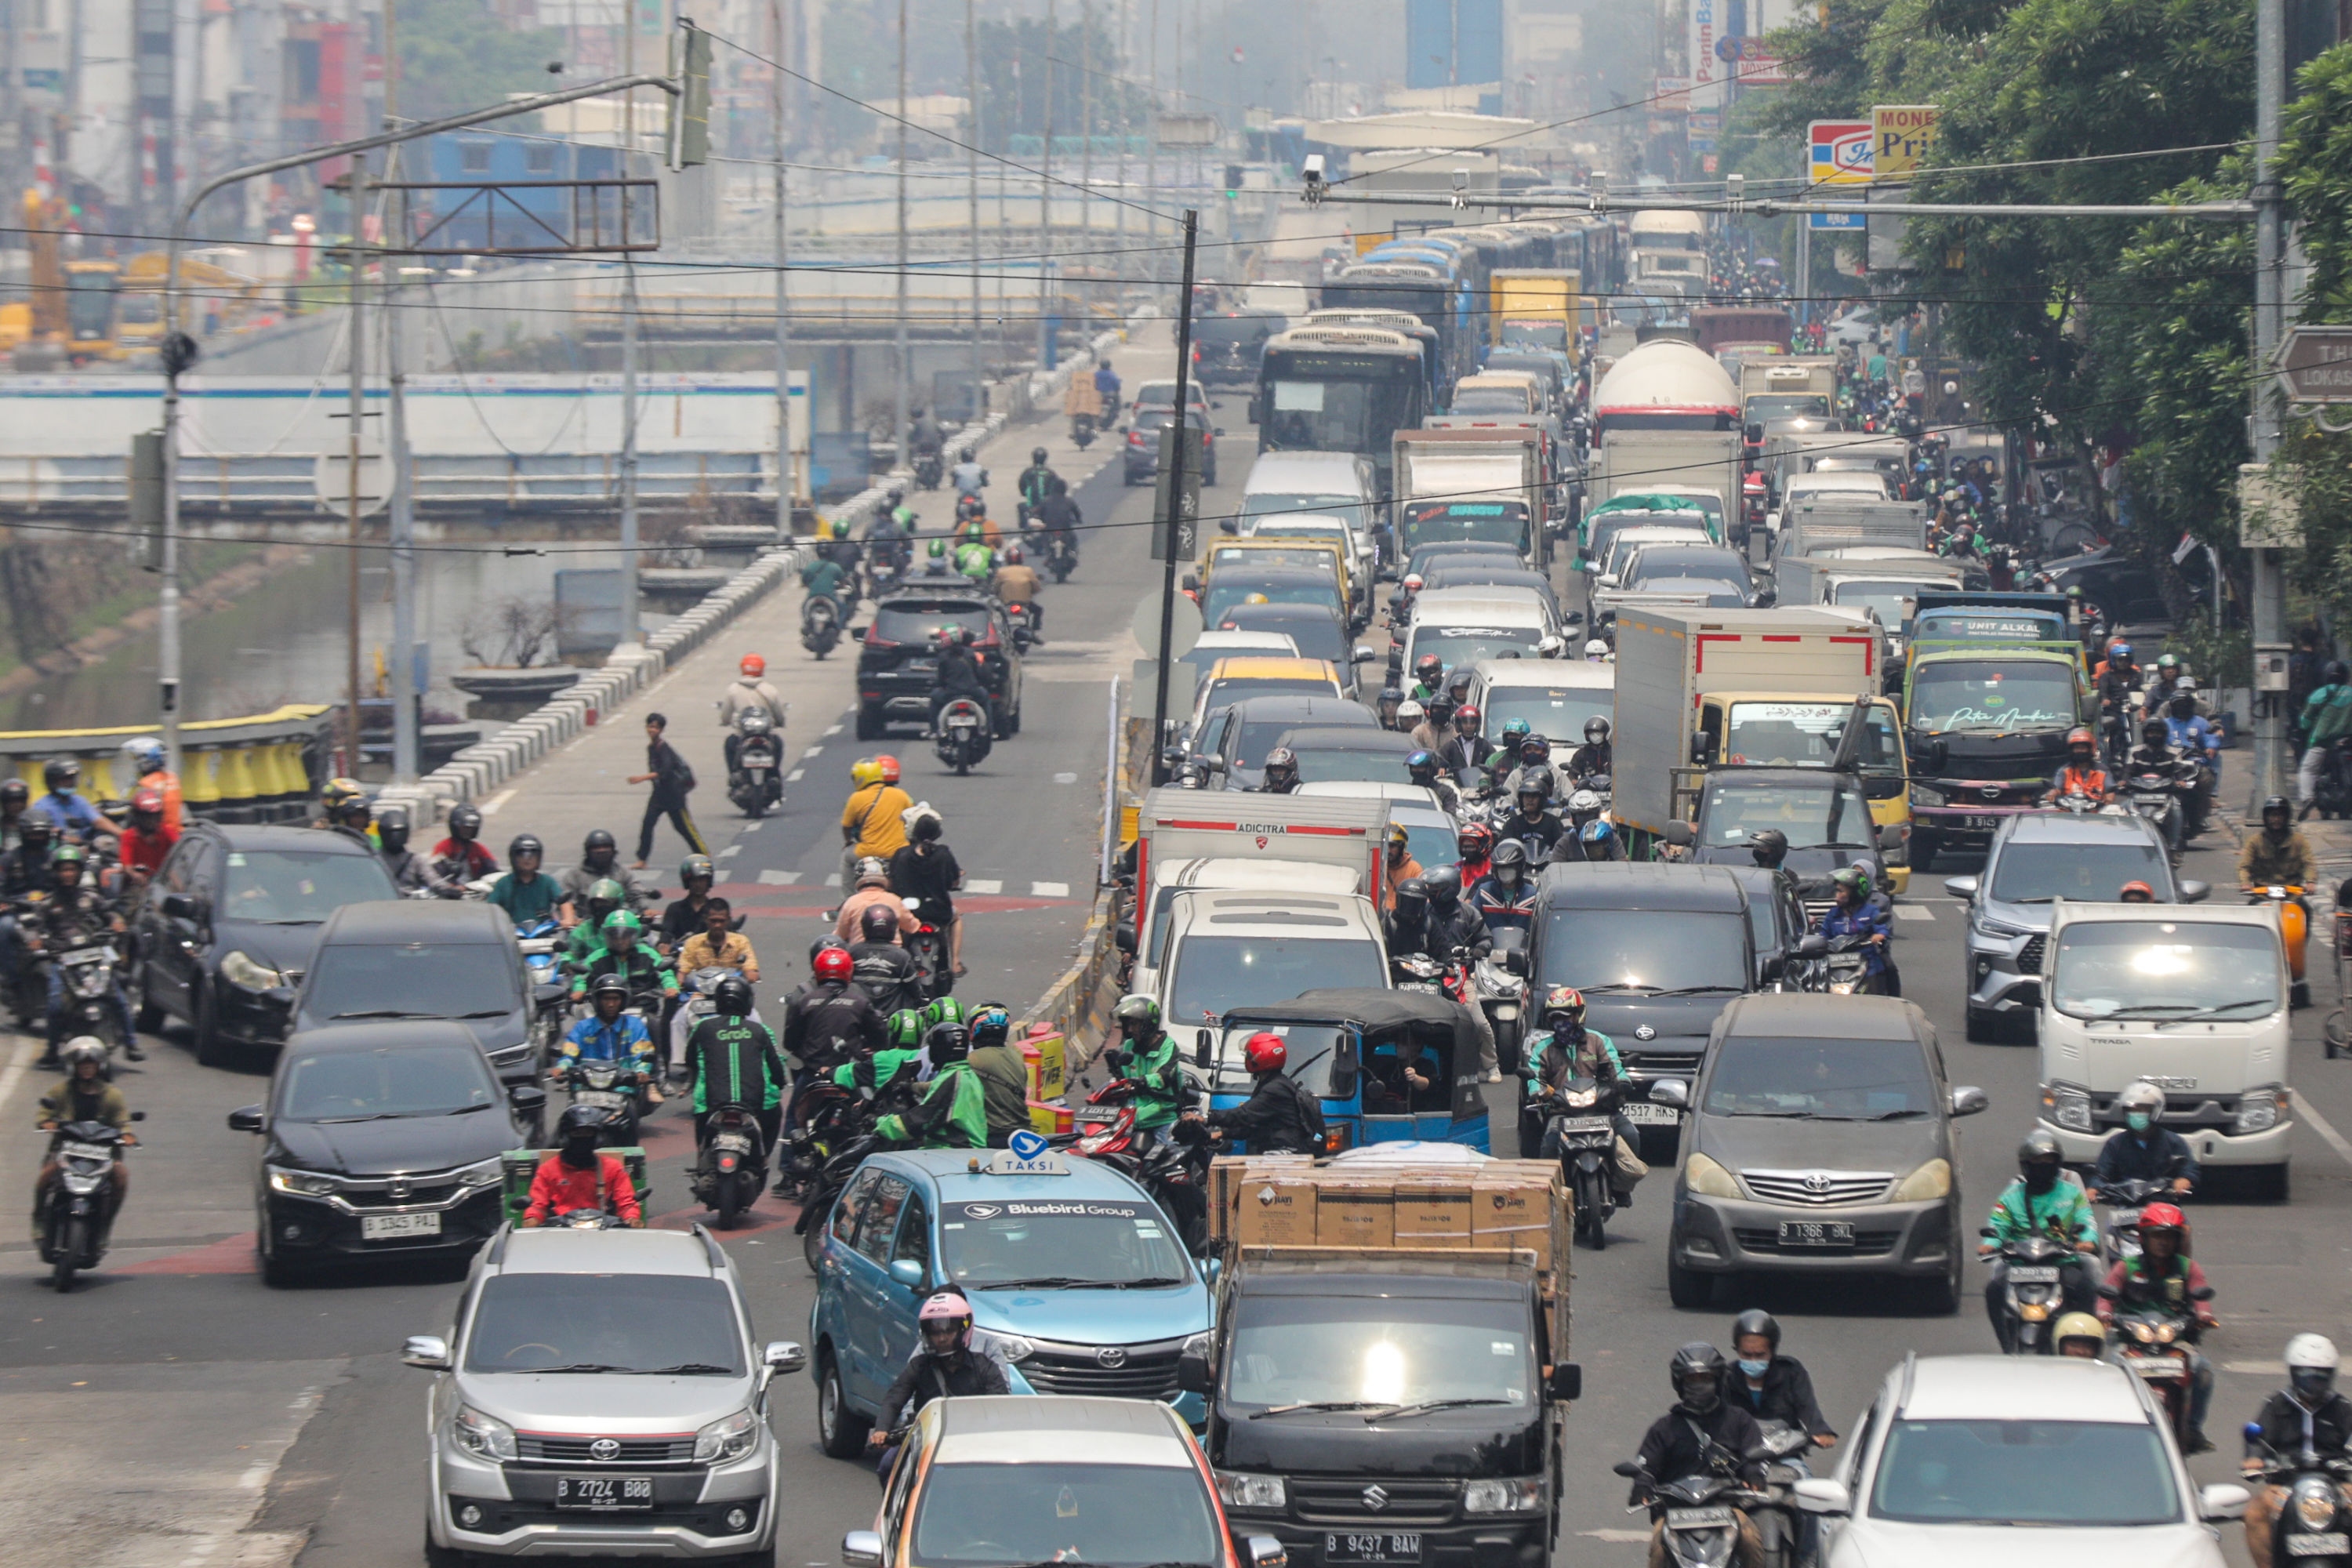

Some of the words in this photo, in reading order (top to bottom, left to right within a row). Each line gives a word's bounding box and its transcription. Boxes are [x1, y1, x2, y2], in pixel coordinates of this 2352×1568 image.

[1967, 622, 1998, 630] UNIT
[2000, 622, 2042, 633] ALKAL
[1238, 824, 1286, 834] ADICITRA
[716, 1028, 753, 1040] Grab
[1655, 1105, 1676, 1119] HKS
[1005, 1161, 1053, 1171] TAKSI
[1008, 1203, 1086, 1214] Bluebird
[1087, 1205, 1136, 1218] Group
[1780, 1224, 1788, 1237] B
[1796, 1225, 1824, 1238] 1366
[557, 1480, 568, 1497] B
[578, 1480, 614, 1497] 2724
[1327, 1535, 1336, 1552] B
[1348, 1535, 1382, 1552] 9437
[1392, 1536, 1420, 1553] BAW
